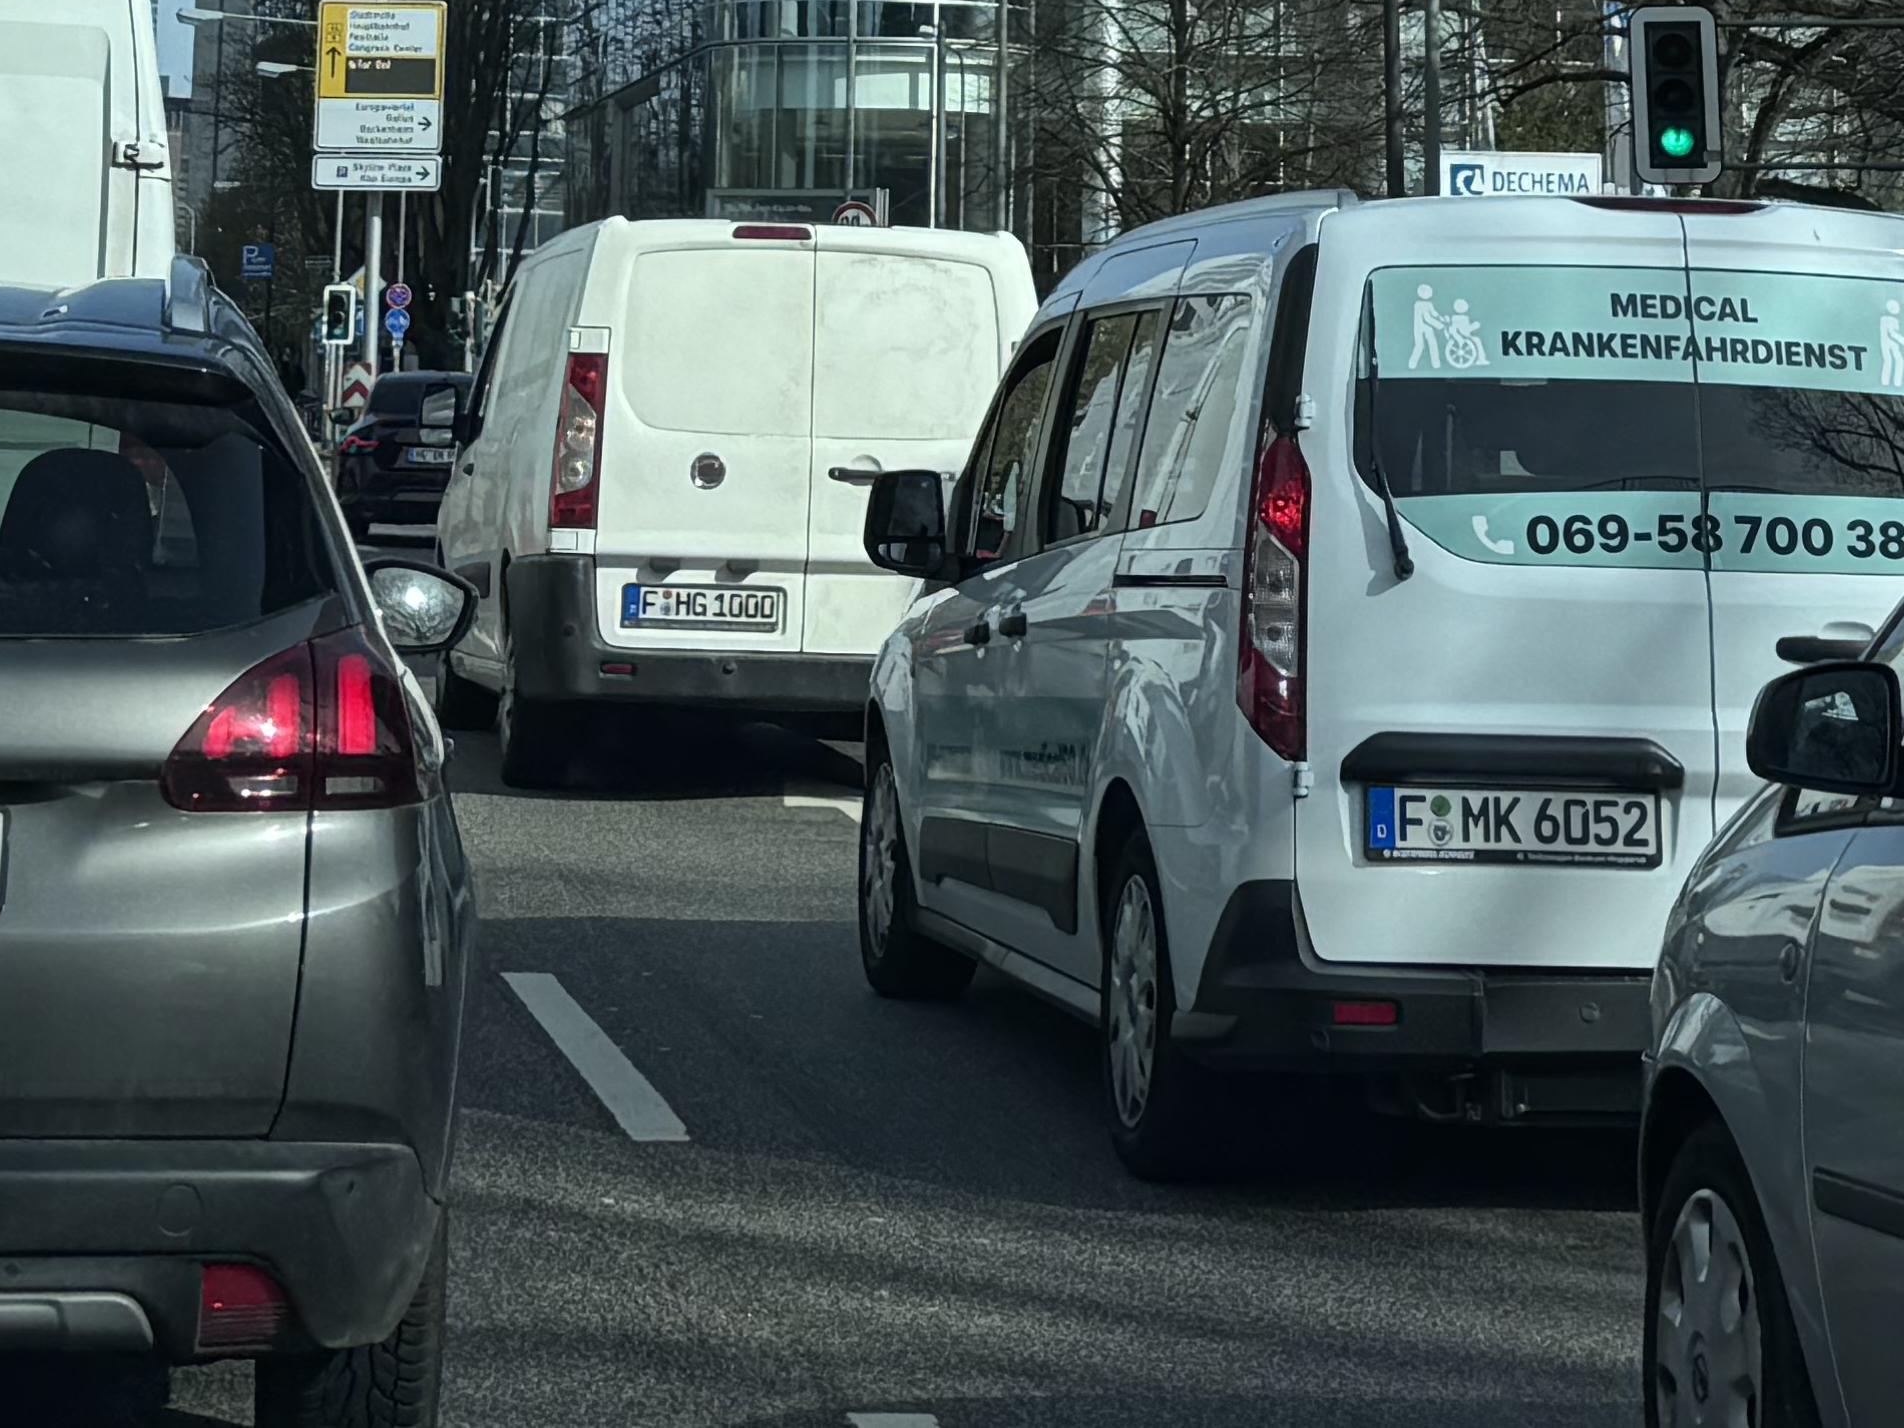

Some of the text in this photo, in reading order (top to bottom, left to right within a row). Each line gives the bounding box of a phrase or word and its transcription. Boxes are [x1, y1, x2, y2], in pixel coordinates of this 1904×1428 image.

[1492, 171, 1590, 193] DECHEMA
[1609, 292, 1758, 324] MEDICAL
[1500, 330, 1868, 372] KRANKENFAHRDIENST
[1526, 512, 1724, 557] 069-58
[1733, 516, 1834, 556] 700
[642, 590, 775, 619] F HG 1000
[1399, 794, 1650, 847] F MK 6052
